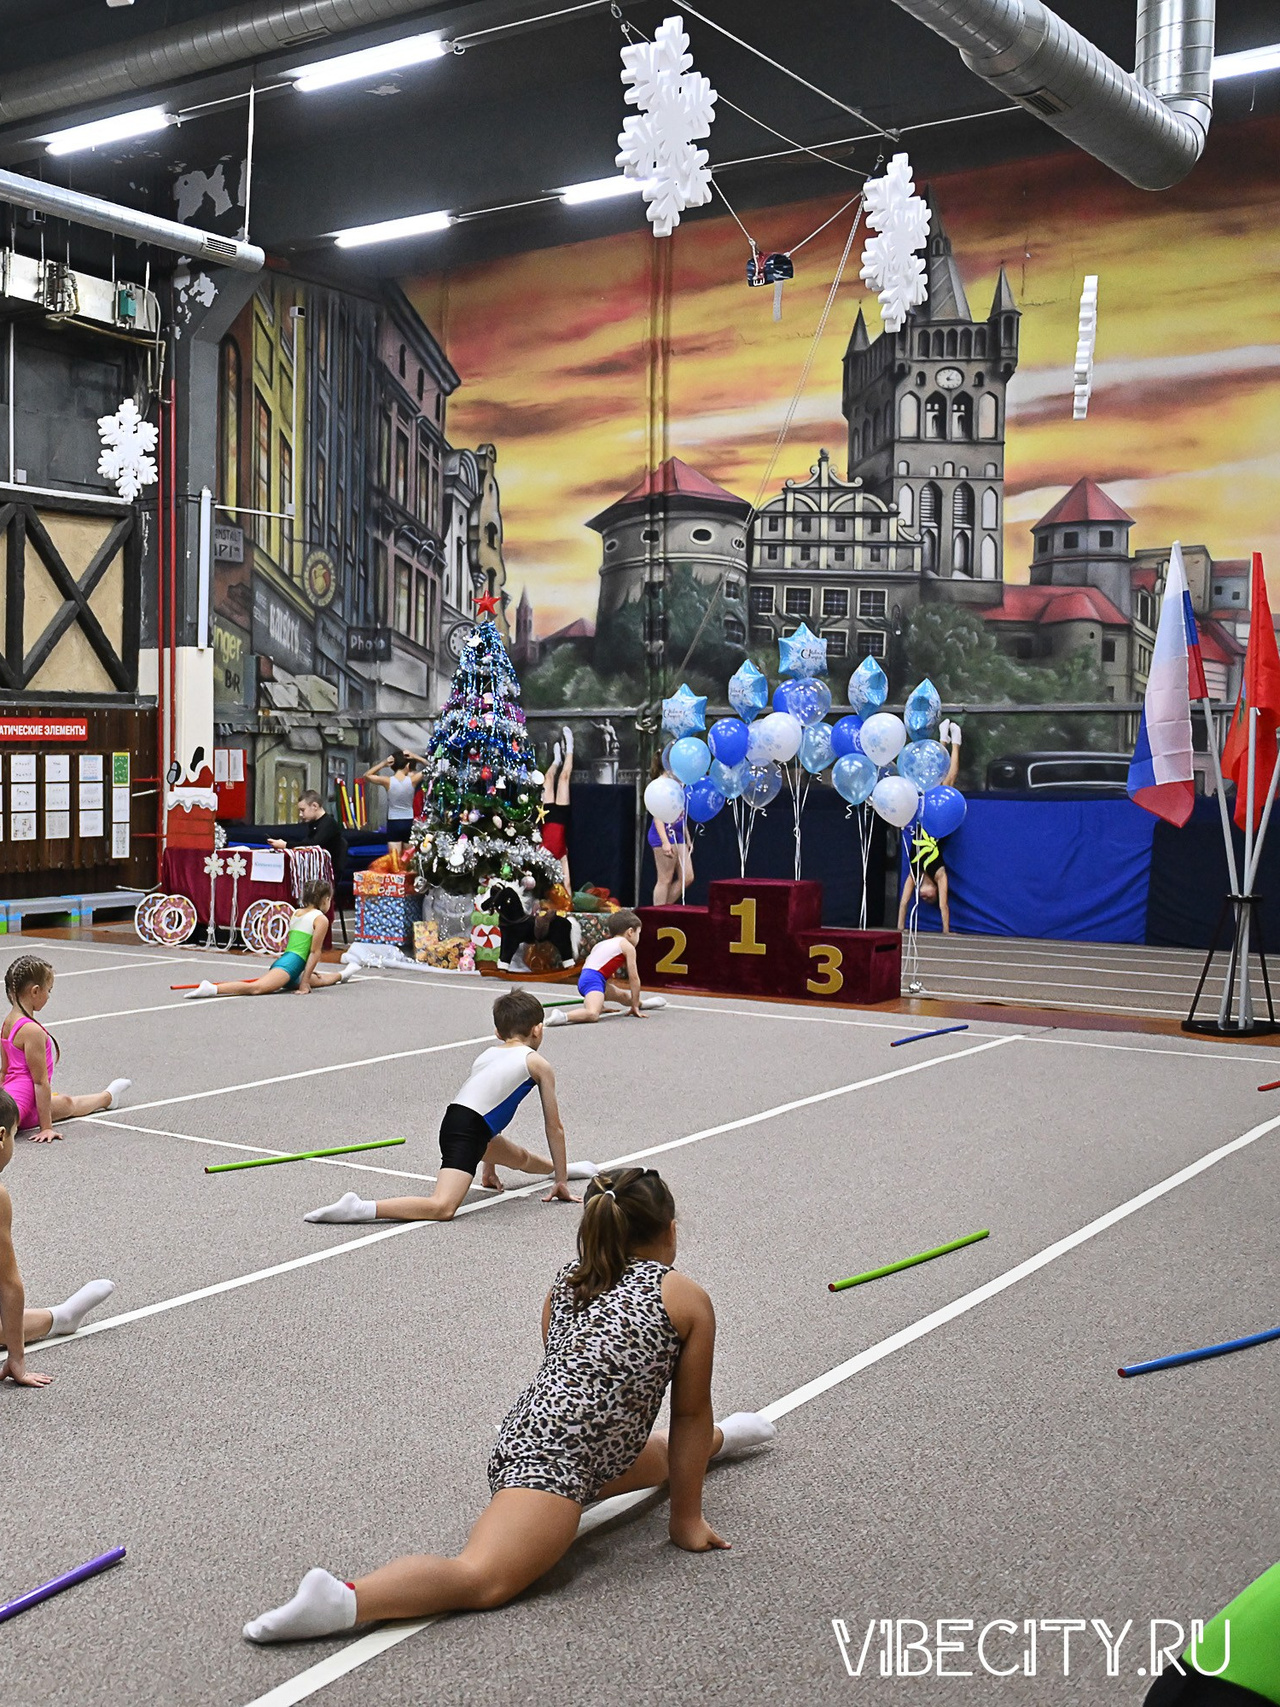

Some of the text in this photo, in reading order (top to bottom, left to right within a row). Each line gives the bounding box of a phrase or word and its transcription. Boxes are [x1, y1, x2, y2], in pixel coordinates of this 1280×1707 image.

[43, 725, 86, 735] ЭЛЕМЕНТЫ
[655, 927, 689, 975] 2
[729, 898, 766, 955] 1
[806, 944, 844, 995] 3
